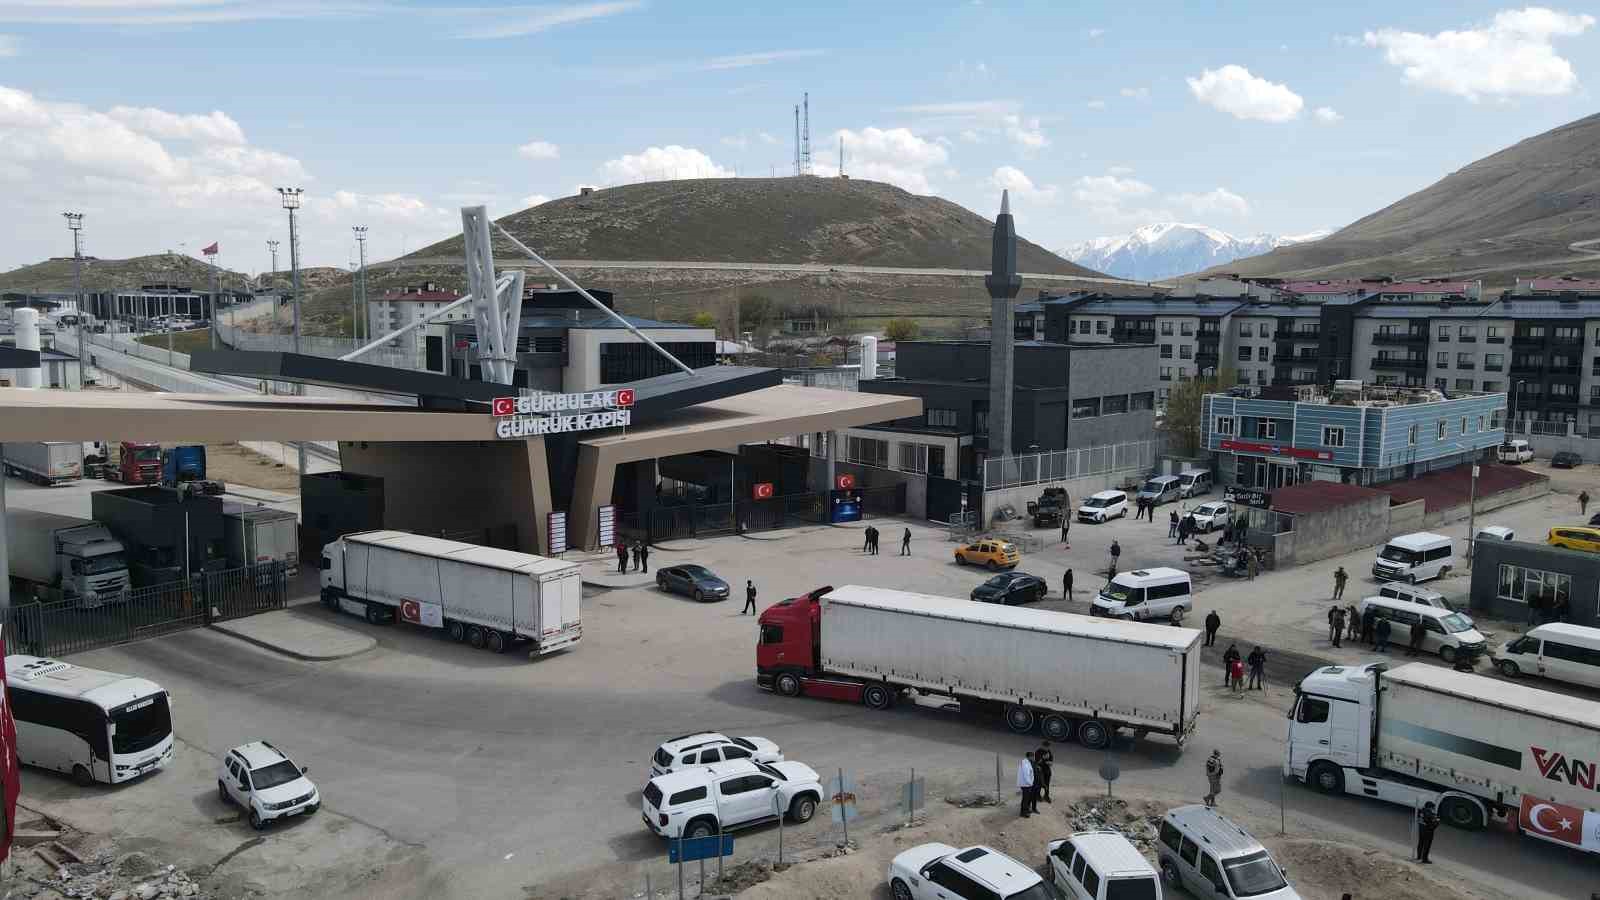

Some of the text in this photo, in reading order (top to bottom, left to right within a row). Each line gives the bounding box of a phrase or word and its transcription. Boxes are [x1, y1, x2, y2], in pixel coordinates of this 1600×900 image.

[518, 391, 616, 412] GÜRBULAK
[497, 409, 631, 438] GÜMRÜK KAPISI
